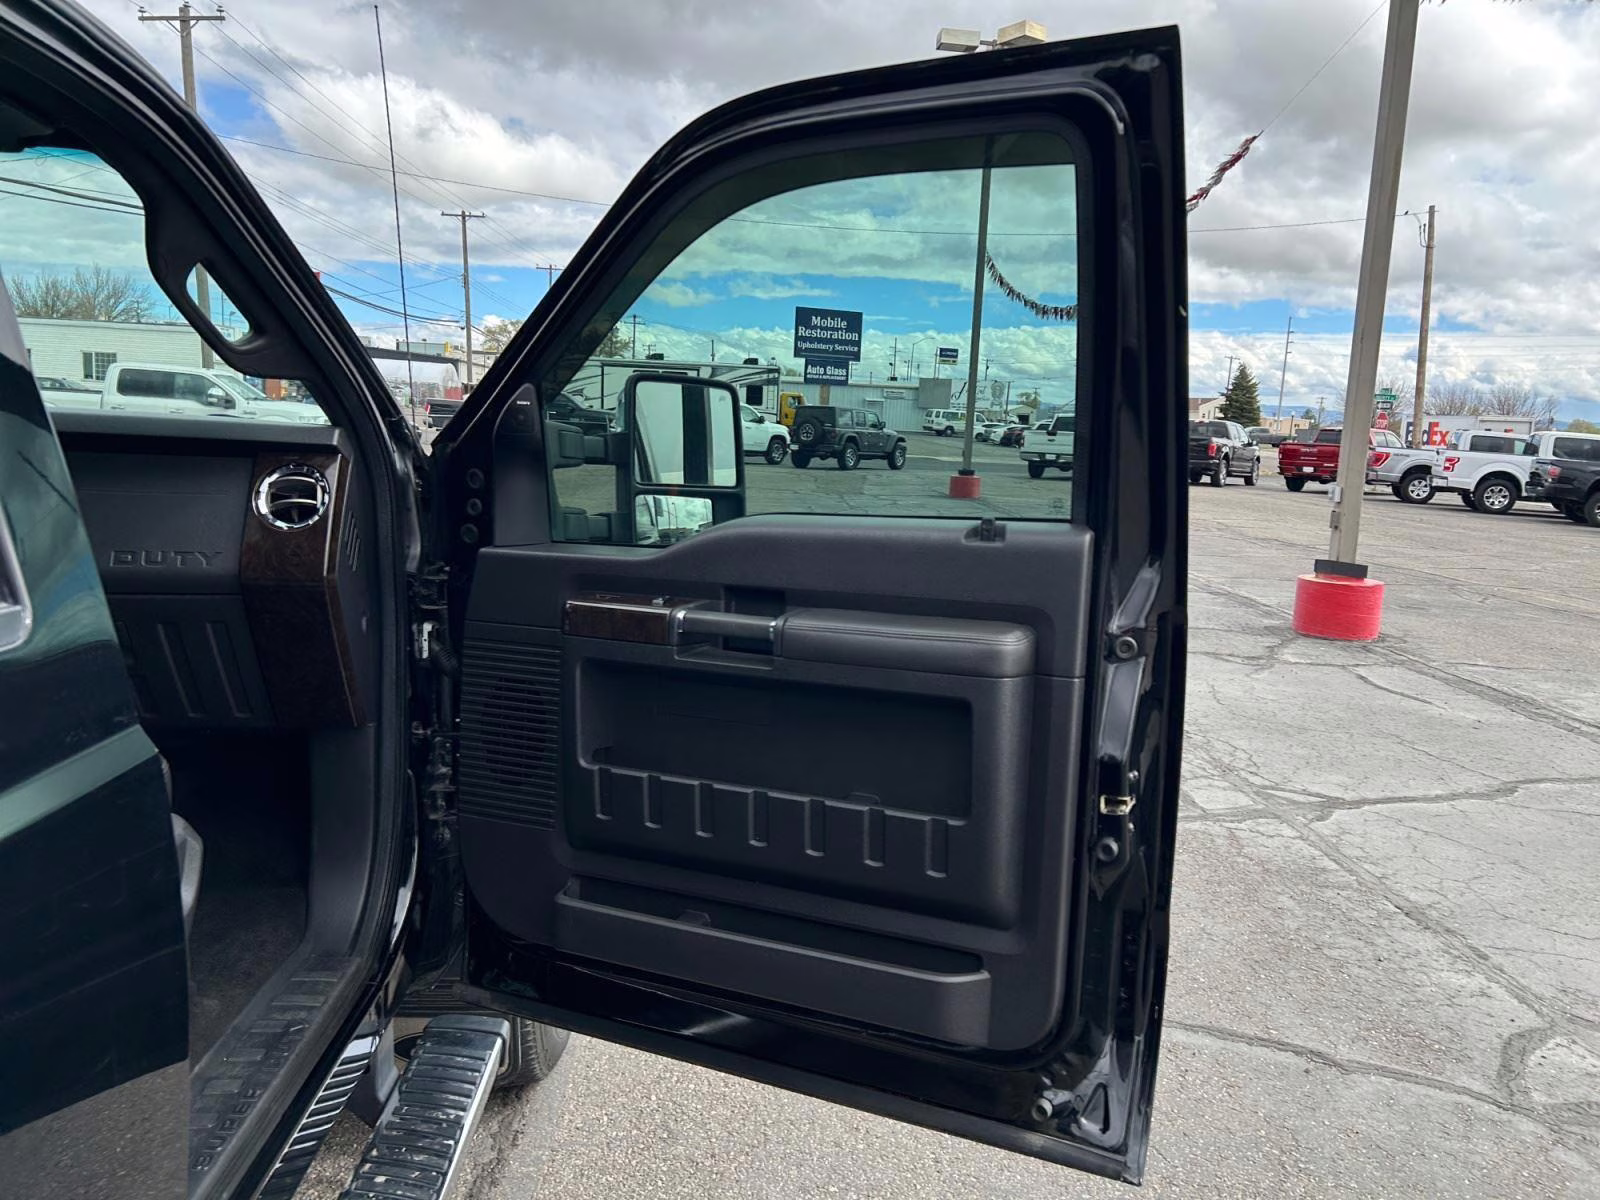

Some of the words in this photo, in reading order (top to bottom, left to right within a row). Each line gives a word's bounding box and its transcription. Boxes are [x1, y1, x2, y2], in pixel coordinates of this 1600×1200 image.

[811, 316, 847, 328] Mobile
[798, 327, 859, 340] Restoration
[798, 341, 833, 351] Upholstery
[834, 344, 859, 352] Service
[806, 365, 825, 375] Auto
[826, 366, 848, 376] Glass
[1406, 421, 1449, 446] FdEx
[109, 550, 224, 569] DUTY
